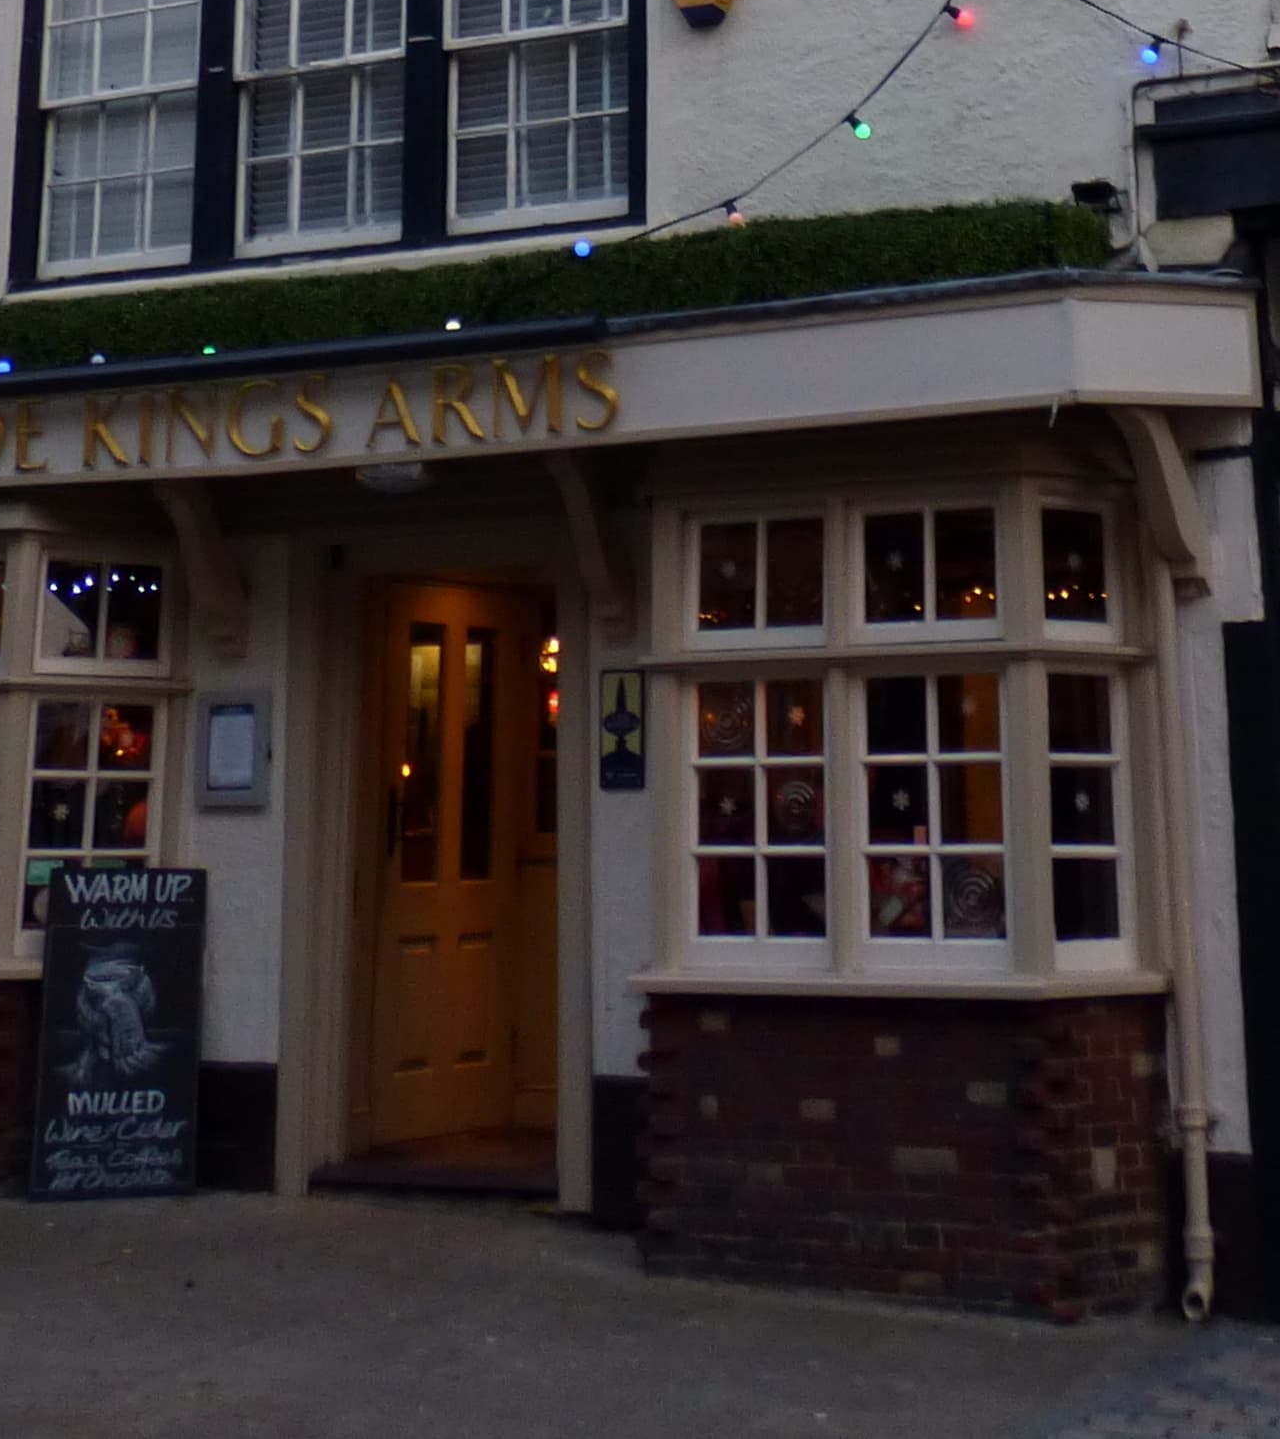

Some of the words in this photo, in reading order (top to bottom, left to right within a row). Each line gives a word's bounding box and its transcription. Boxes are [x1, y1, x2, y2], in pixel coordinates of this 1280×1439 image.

[82, 371, 336, 468] KINGS
[365, 349, 621, 451] ARMS
[65, 873, 148, 904] WARM
[68, 1090, 166, 1116] MULLED
